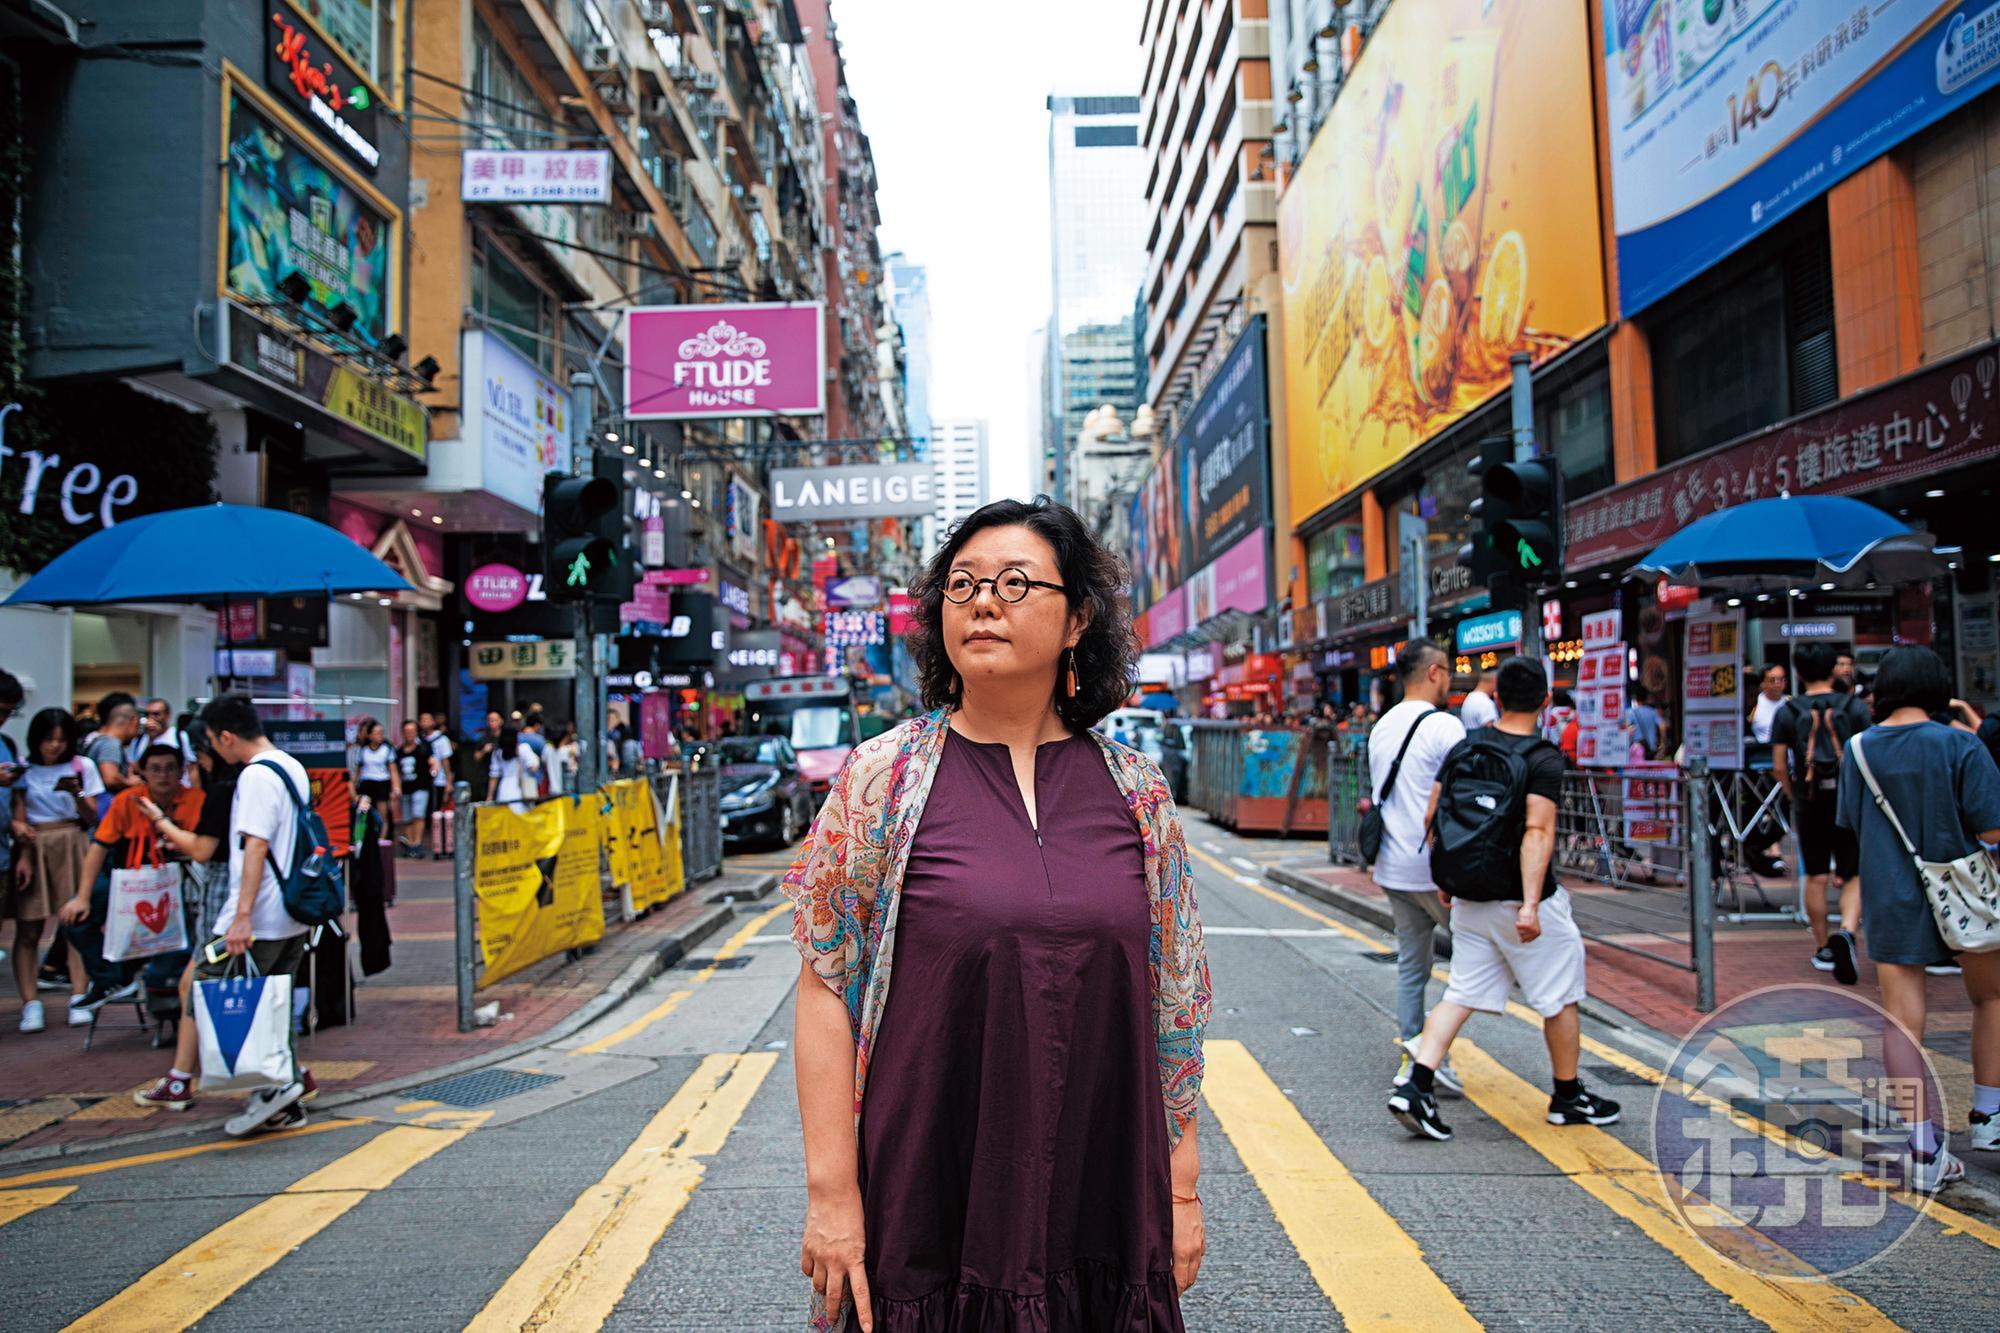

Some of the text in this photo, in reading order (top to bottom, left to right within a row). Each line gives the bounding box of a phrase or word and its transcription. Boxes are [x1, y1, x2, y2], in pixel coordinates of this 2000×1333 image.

[673, 359, 772, 388] ETUDE
[688, 389, 756, 406] HOUSE
[774, 475, 931, 508] LANEIGE
